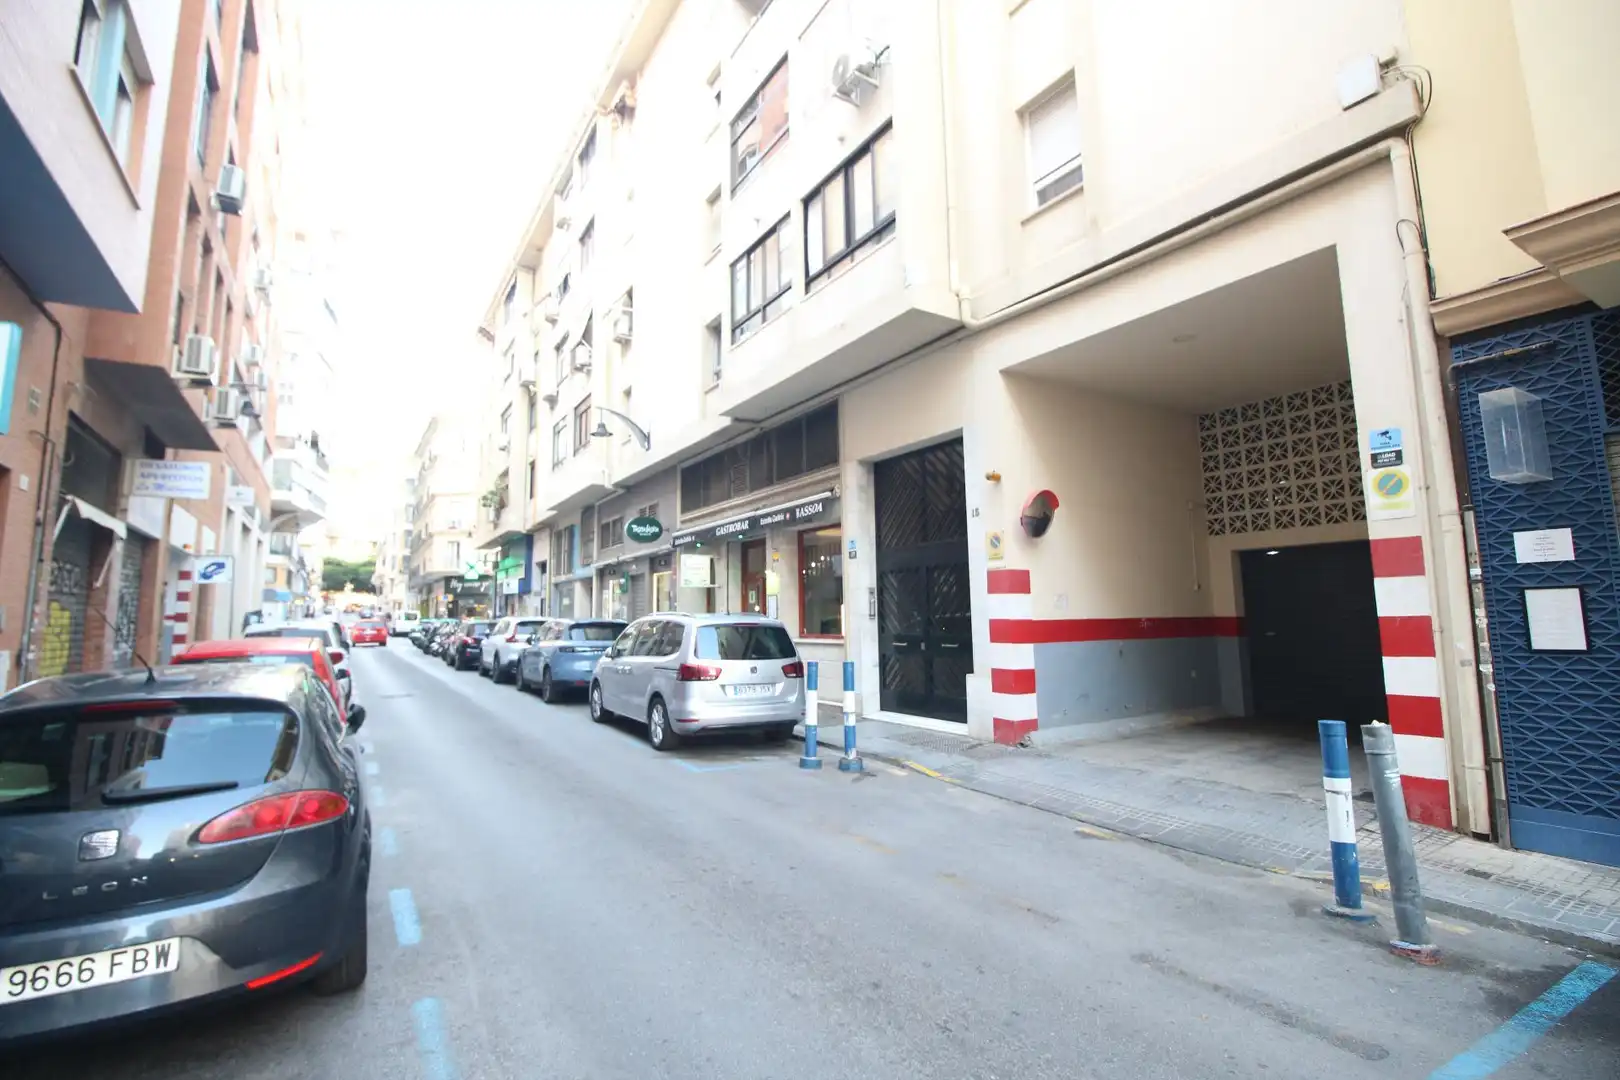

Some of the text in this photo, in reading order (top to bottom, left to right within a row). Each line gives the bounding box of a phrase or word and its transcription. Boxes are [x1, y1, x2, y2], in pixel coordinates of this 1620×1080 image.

[715, 520, 749, 536] GASTROBAR
[42, 875, 148, 900] LEON
[7, 942, 171, 997] 9666 FBW
